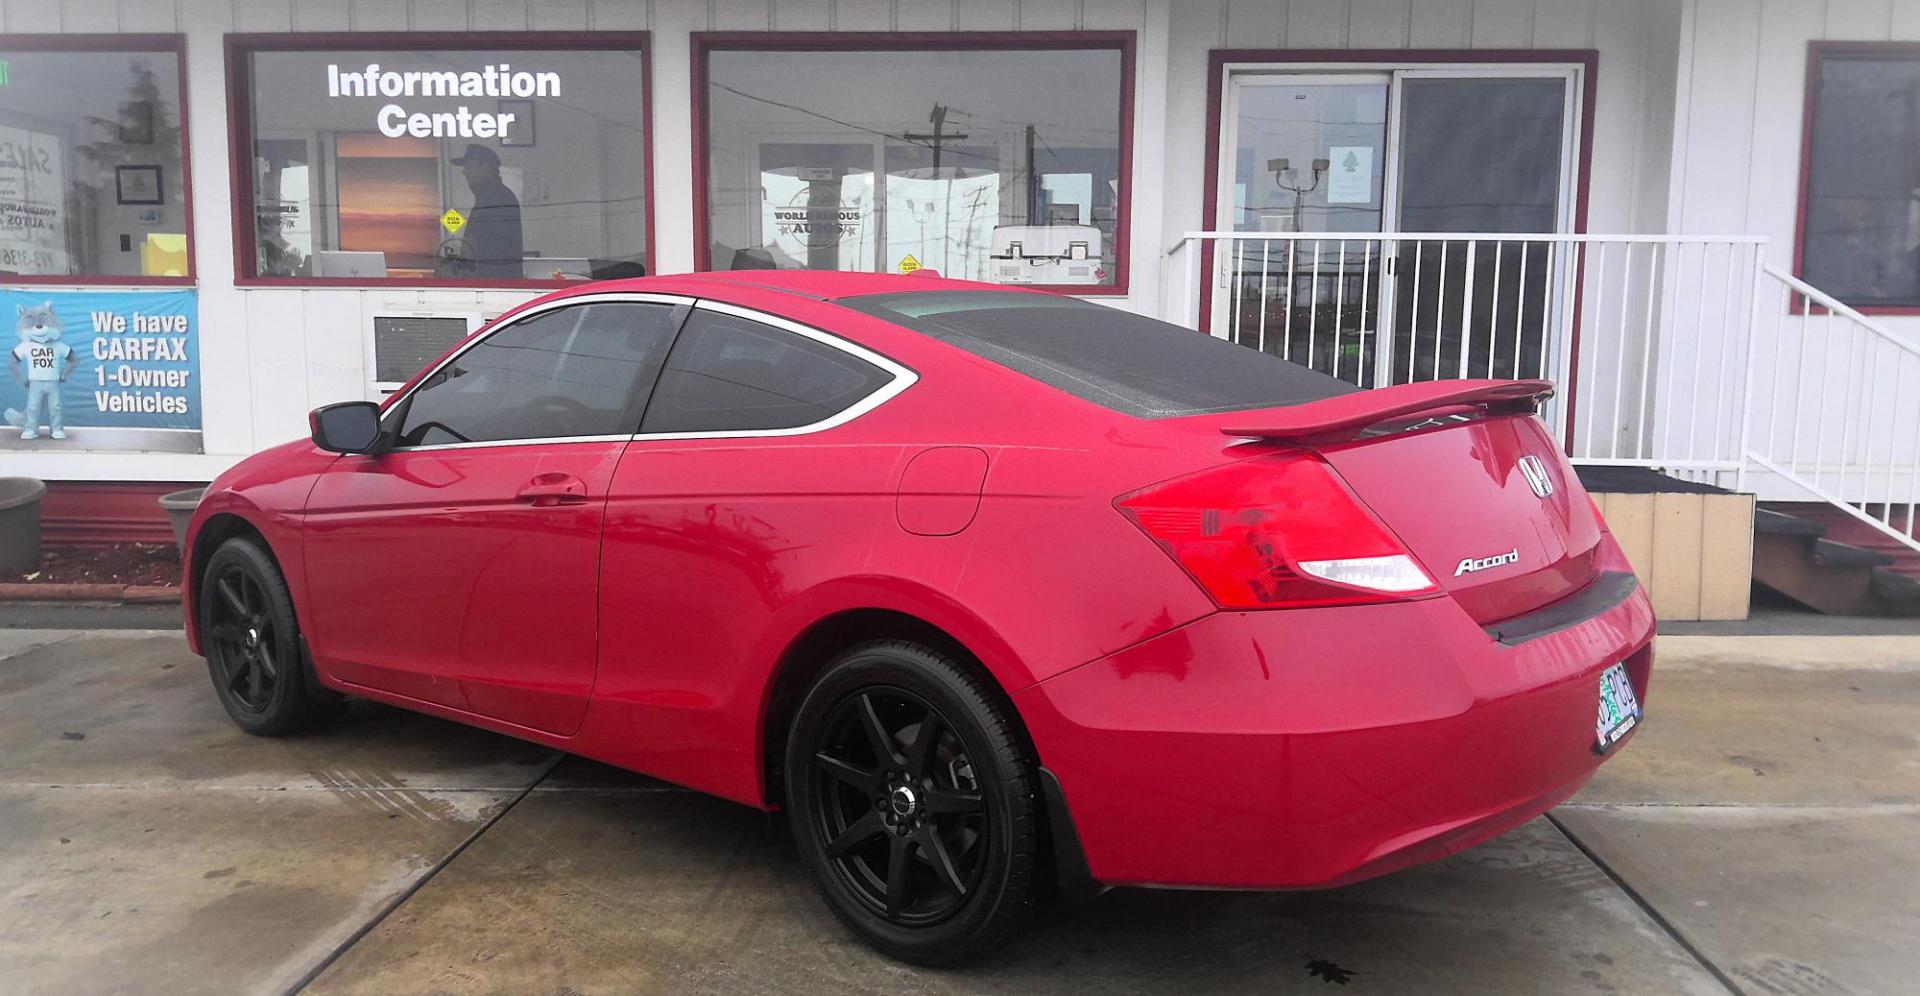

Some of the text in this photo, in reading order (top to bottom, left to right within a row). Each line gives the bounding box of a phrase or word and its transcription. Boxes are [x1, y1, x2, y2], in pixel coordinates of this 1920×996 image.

[327, 63, 561, 98] Information
[377, 104, 515, 138] Center
[816, 211, 861, 221] OUS
[91, 311, 188, 334] We have
[31, 348, 55, 358] CAR
[93, 337, 188, 361] CARFAX
[33, 358, 55, 369] FOX
[95, 365, 190, 387] 1-Owner
[95, 391, 188, 414] Vehicles
[1453, 548, 1519, 577] Accord
